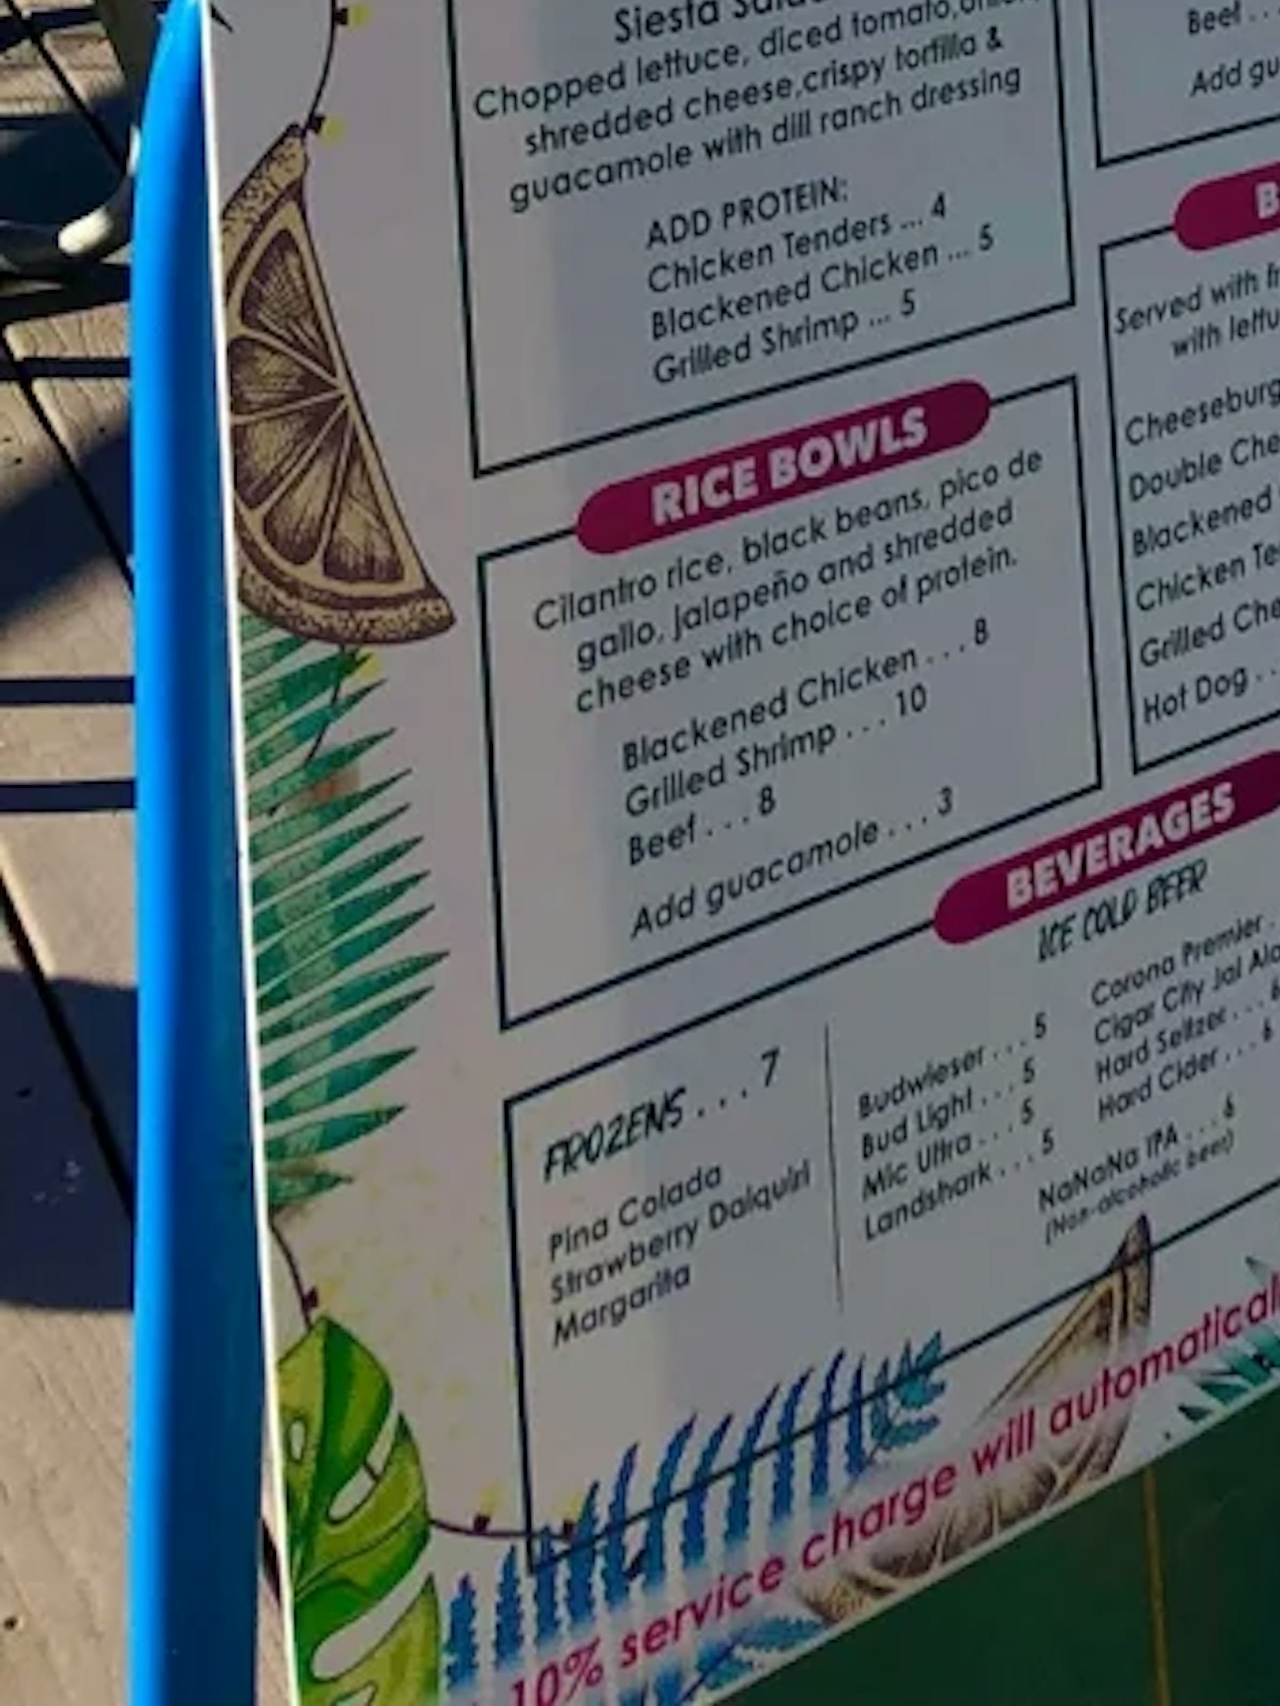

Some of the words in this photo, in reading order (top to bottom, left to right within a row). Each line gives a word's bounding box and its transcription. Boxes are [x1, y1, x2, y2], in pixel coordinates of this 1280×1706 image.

[645, 208, 712, 250] ADD
[721, 175, 848, 231] PROTEIN:
[647, 243, 774, 293] Chicken
[781, 213, 892, 259] Tenders
[930, 192, 946, 219] 4
[651, 272, 811, 341] Blackened
[821, 243, 938, 293] Chicken
[979, 222, 994, 252] 5
[1115, 284, 1203, 336] Served
[1210, 269, 1259, 305] with
[652, 332, 751, 385] Grilled
[761, 310, 859, 357] Shrimp
[900, 287, 915, 318] 5
[652, 454, 759, 526] RICE
[770, 409, 928, 484] BOWLS
[1128, 451, 1223, 503] Double
[533, 574, 658, 631] Cilantro
[667, 551, 732, 590] rice,
[742, 515, 828, 565] black
[835, 488, 930, 535] beans,
[939, 464, 999, 509] pico
[1008, 448, 1043, 480] de
[1132, 483, 1272, 559] Blackened
[1135, 556, 1246, 612] Chicken
[622, 686, 788, 773] Blackened
[796, 648, 918, 708] Chicken
[974, 617, 990, 646] 8
[1143, 682, 1188, 726] Hot
[1195, 666, 1249, 705] Dog
[625, 755, 727, 818] Grilled
[735, 723, 837, 778] Shrimp
[896, 682, 927, 717] 10
[1006, 783, 1236, 909] BEVERAGES
[760, 1046, 780, 1088] 7
[1034, 1011, 1047, 1040] 5
[1098, 1074, 1152, 1122] Hard
[1158, 1047, 1219, 1092] Cider
[1262, 1017, 1273, 1043] 6
[862, 1115, 908, 1161] Bud
[916, 1085, 973, 1134] Light
[1022, 1056, 1036, 1085] 5
[618, 1165, 722, 1228] Colada
[864, 1160, 992, 1242] Landshark
[1042, 1127, 1055, 1156] 5
[550, 1218, 699, 1305] Strawberry
[553, 1264, 690, 1349] Margarita
[512, 1639, 602, 1706] 10%
[621, 1555, 784, 1668] service
[802, 1461, 957, 1572] charge
[972, 1410, 1034, 1479] will
